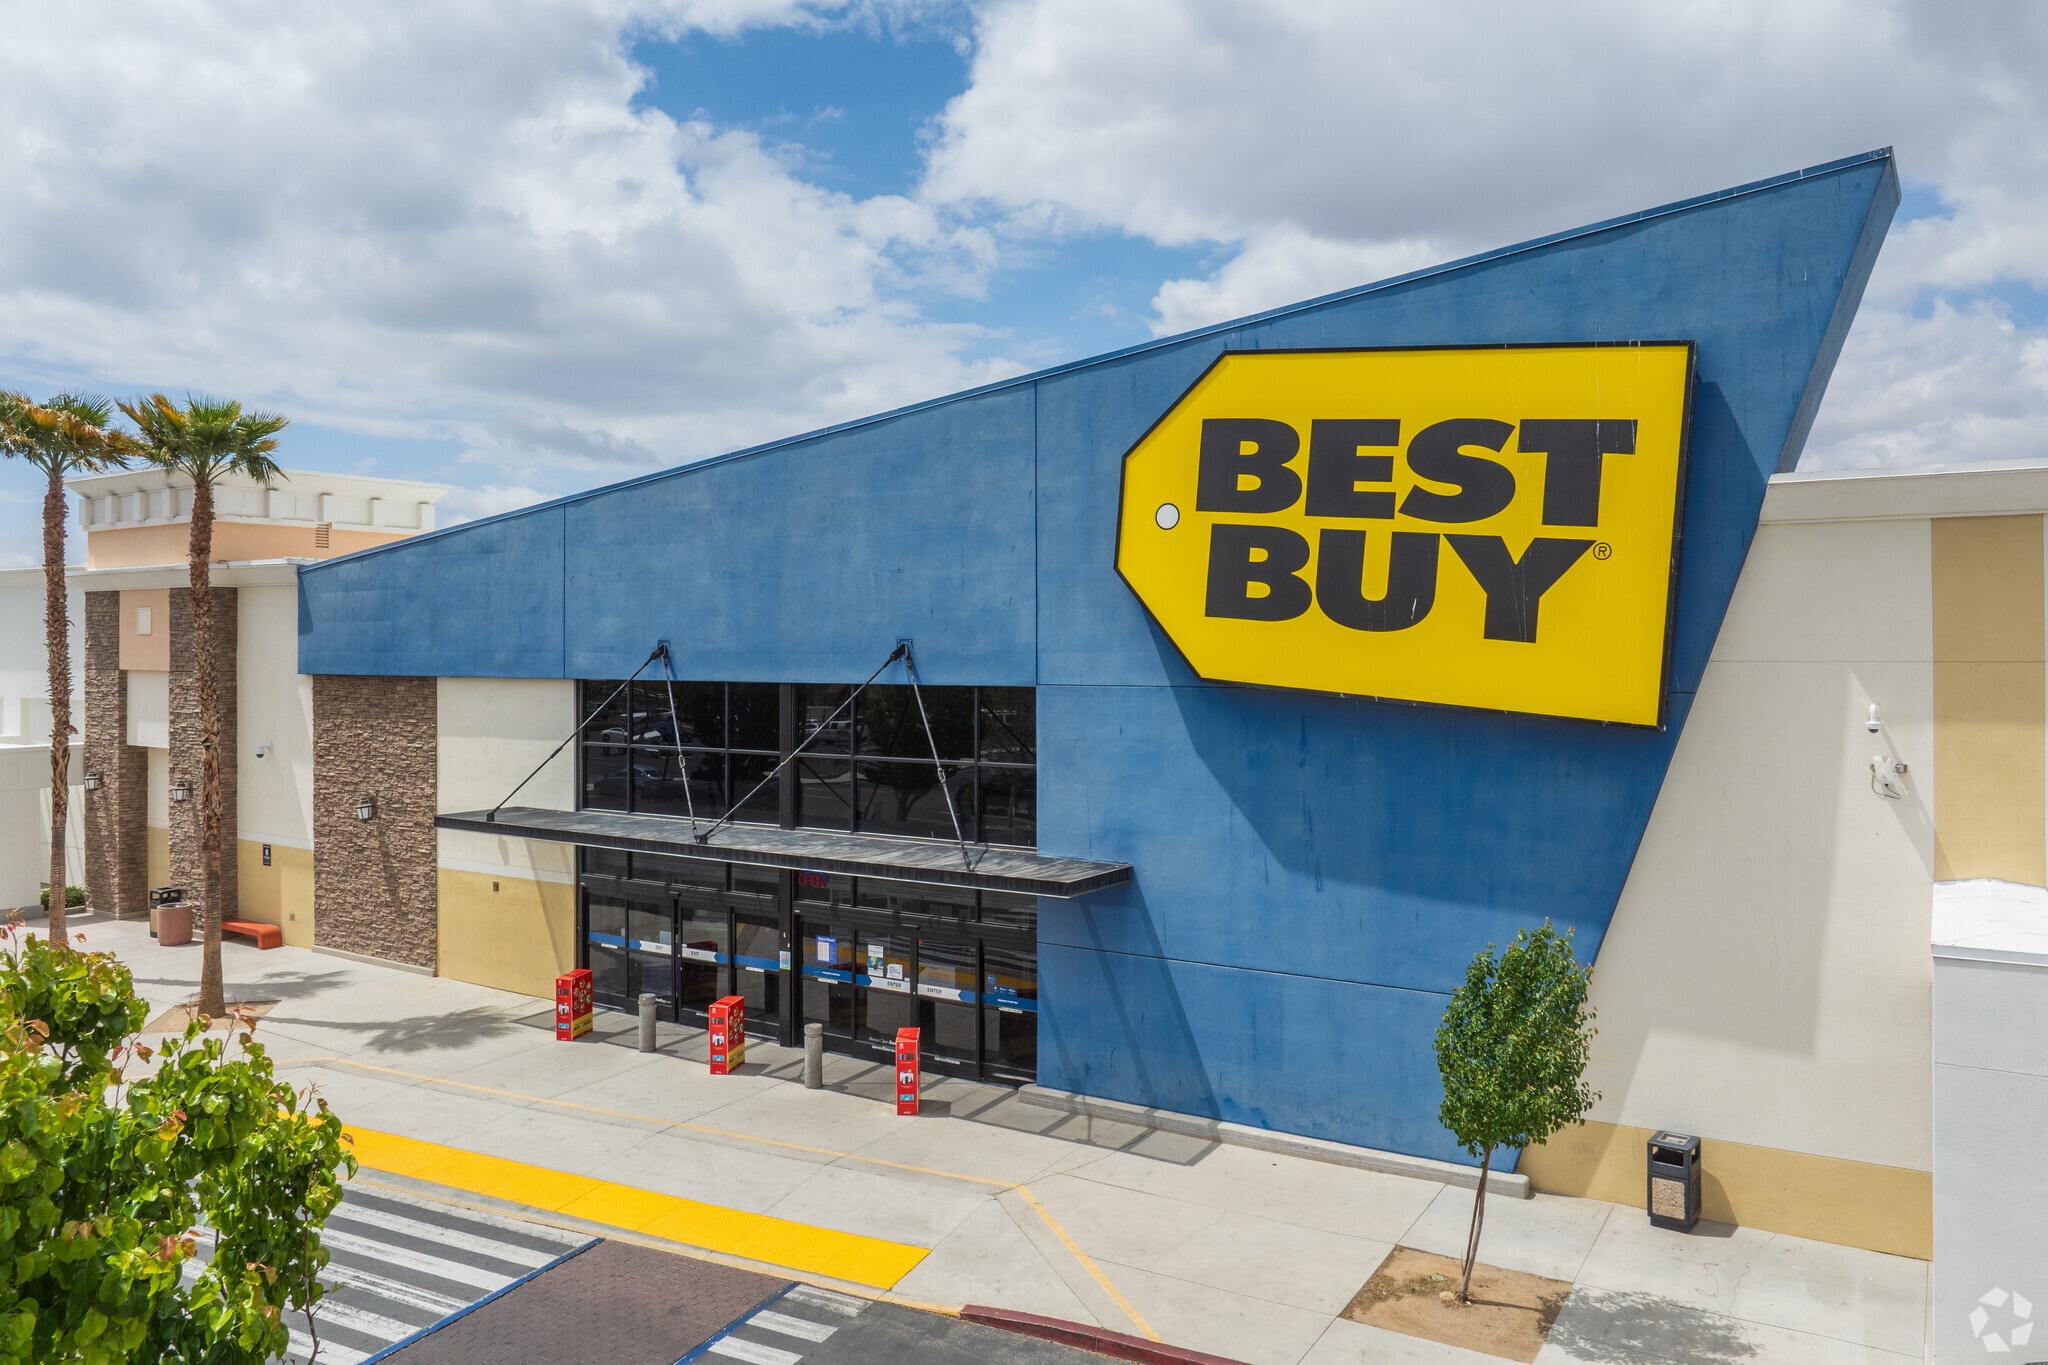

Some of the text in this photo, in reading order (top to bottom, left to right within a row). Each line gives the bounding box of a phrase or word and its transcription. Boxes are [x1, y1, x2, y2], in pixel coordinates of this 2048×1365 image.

[1195, 418, 1638, 527] BEST
[1204, 523, 1597, 643] BUY
[798, 873, 827, 889] OPEN
